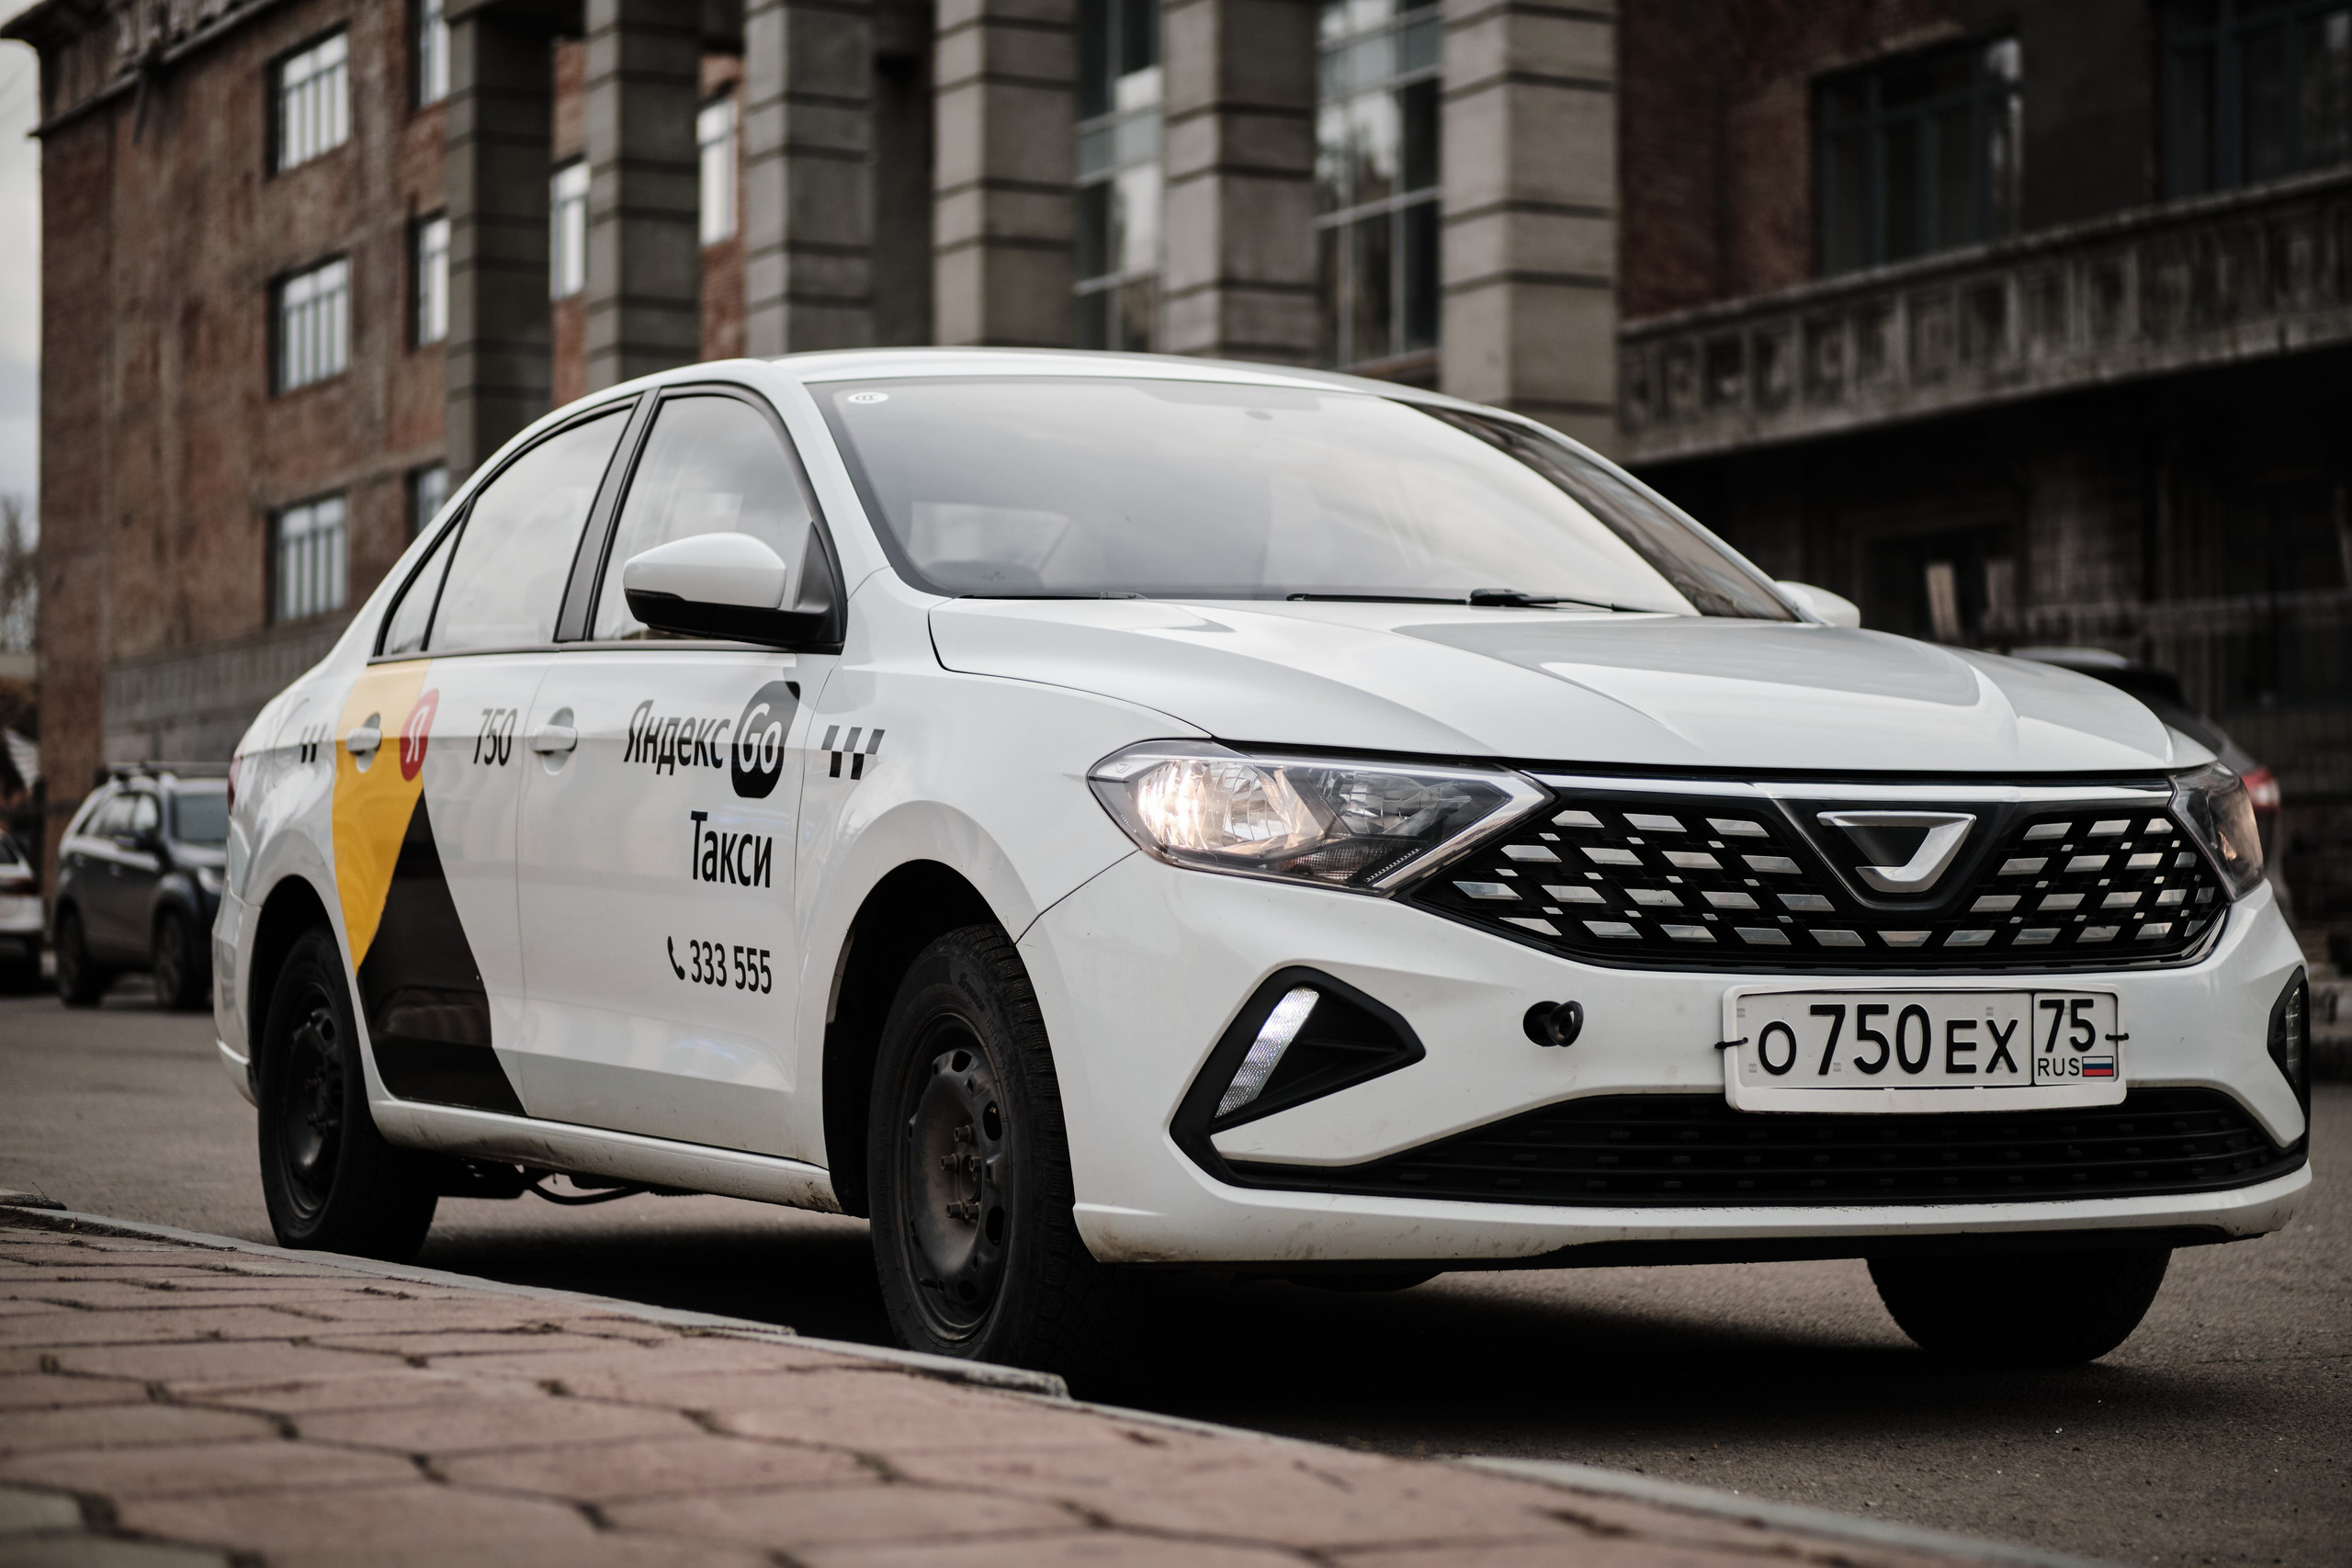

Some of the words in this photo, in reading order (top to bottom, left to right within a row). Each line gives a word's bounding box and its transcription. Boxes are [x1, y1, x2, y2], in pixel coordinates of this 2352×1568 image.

[406, 705, 431, 764] Я
[473, 707, 518, 766] 750
[623, 699, 731, 776] Яндекс
[738, 703, 783, 774] Go
[690, 810, 773, 888] Такси
[690, 939, 728, 987] 333
[733, 945, 773, 995] 555
[2039, 998, 2097, 1053] 75
[2038, 1057, 2080, 1077] RUS
